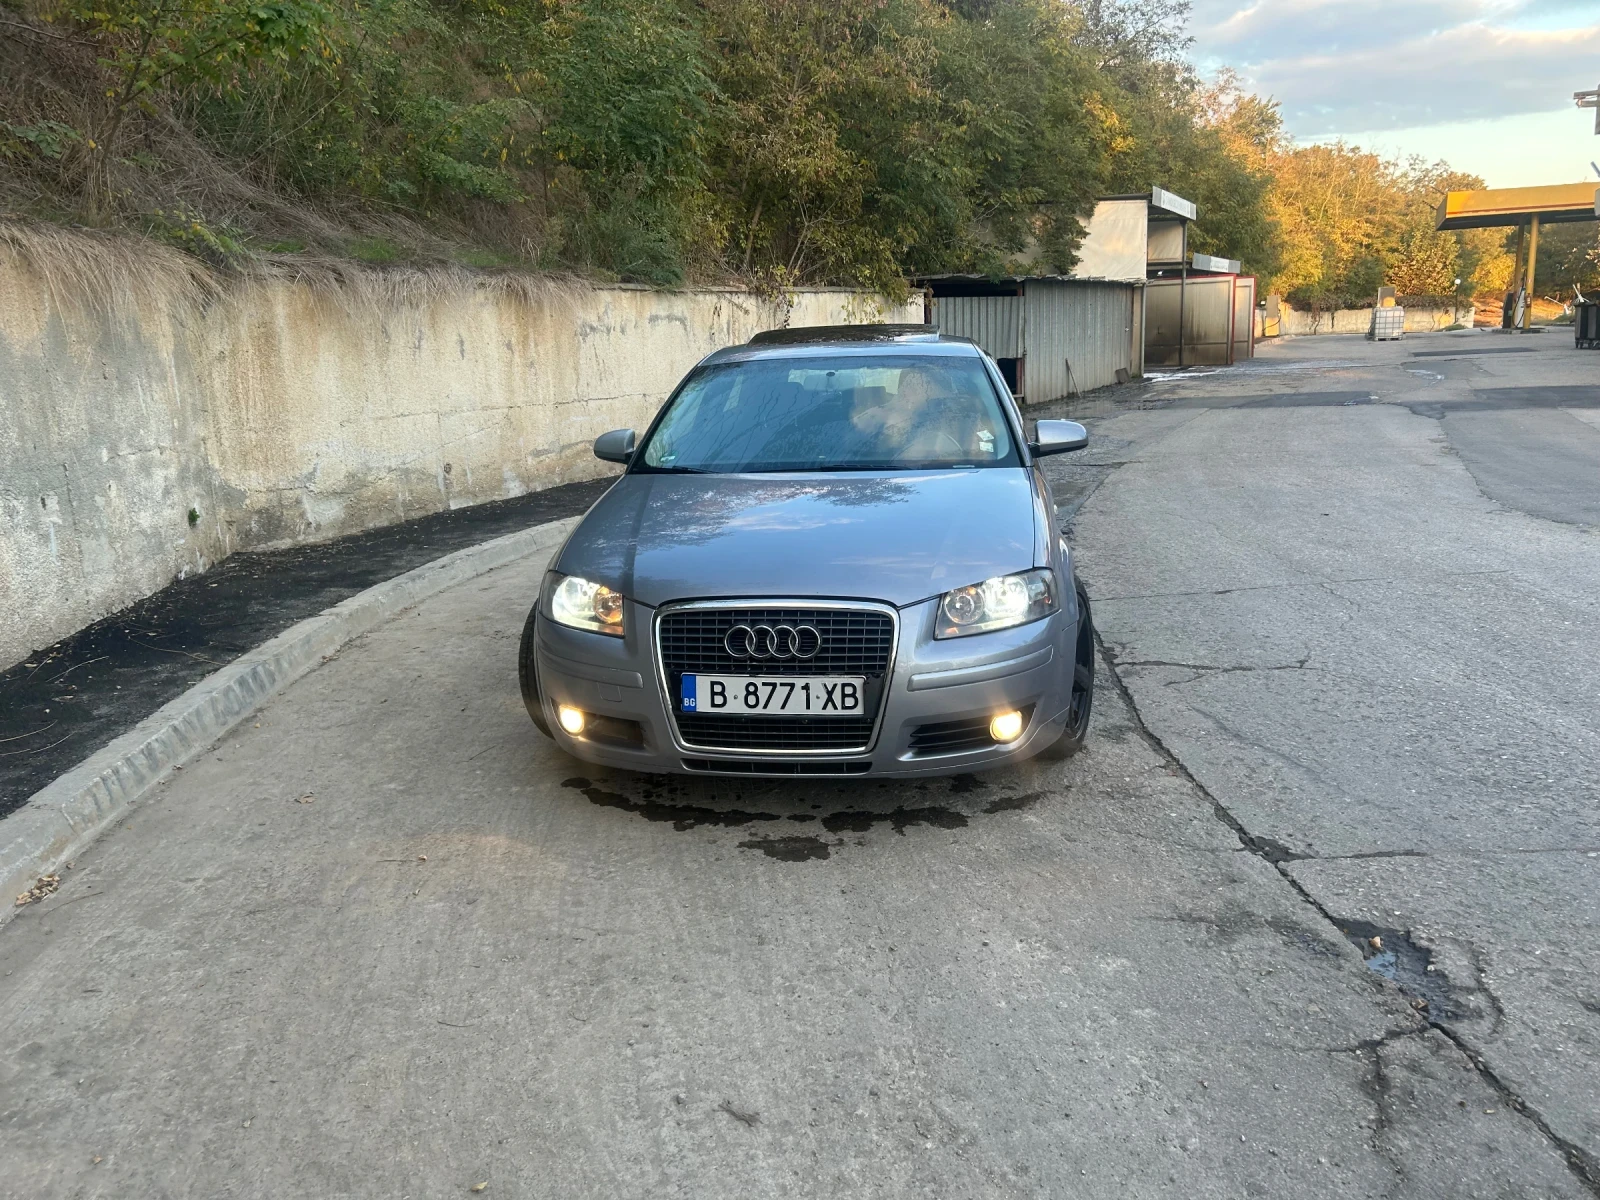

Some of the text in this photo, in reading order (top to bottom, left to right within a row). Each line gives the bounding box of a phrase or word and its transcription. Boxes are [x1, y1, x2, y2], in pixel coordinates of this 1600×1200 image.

[684, 698, 696, 707] BG
[710, 681, 859, 711] B 8771 XB
